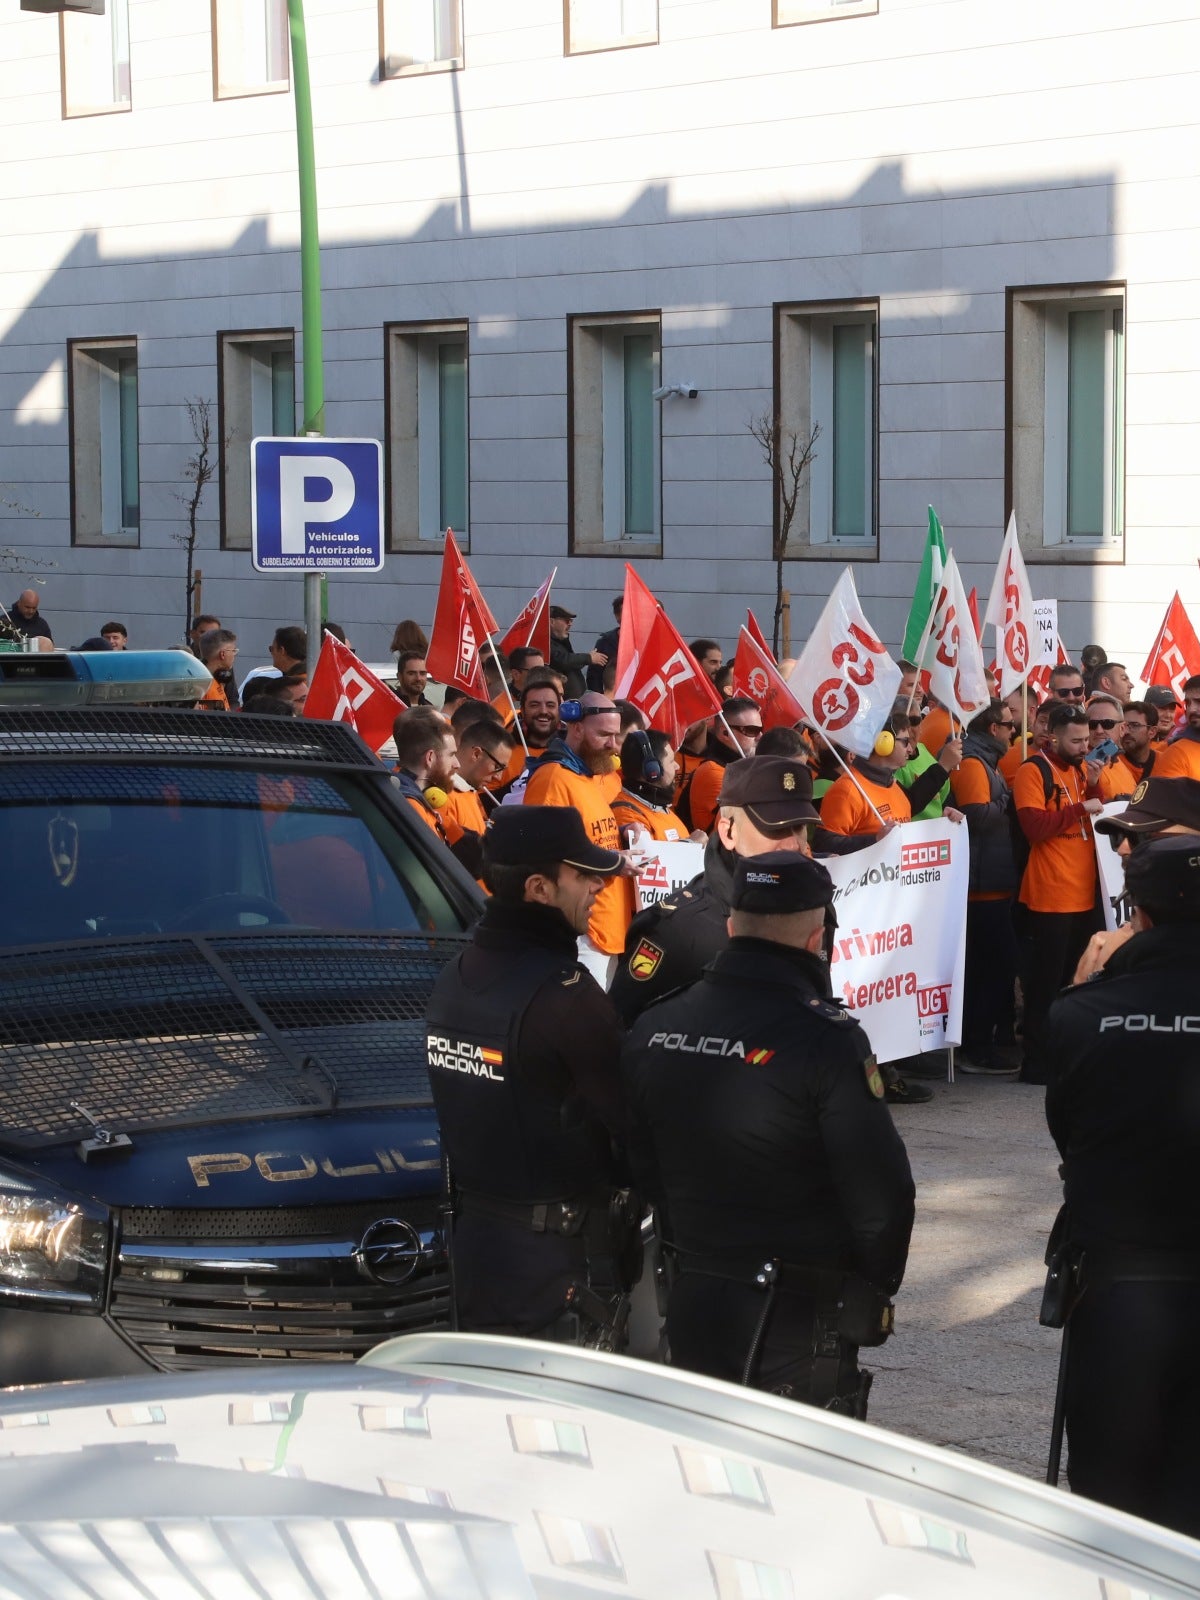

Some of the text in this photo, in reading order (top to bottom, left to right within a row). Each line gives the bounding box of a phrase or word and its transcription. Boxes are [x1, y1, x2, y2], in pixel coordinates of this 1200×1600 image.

[280, 455, 355, 554] P
[262, 556, 376, 566] SUBDELEGACIÓN DEL GOBIERNO DE CÓRDOBA
[308, 545, 373, 555] Autorizados
[901, 847, 938, 866] CCOO
[901, 868, 941, 887] ndustria
[843, 971, 917, 1010] tercera
[427, 1035, 484, 1062] POLICIA
[648, 1032, 746, 1059] POLICIA
[428, 1051, 505, 1081] NACIONAL
[187, 1138, 440, 1187] POLIC
